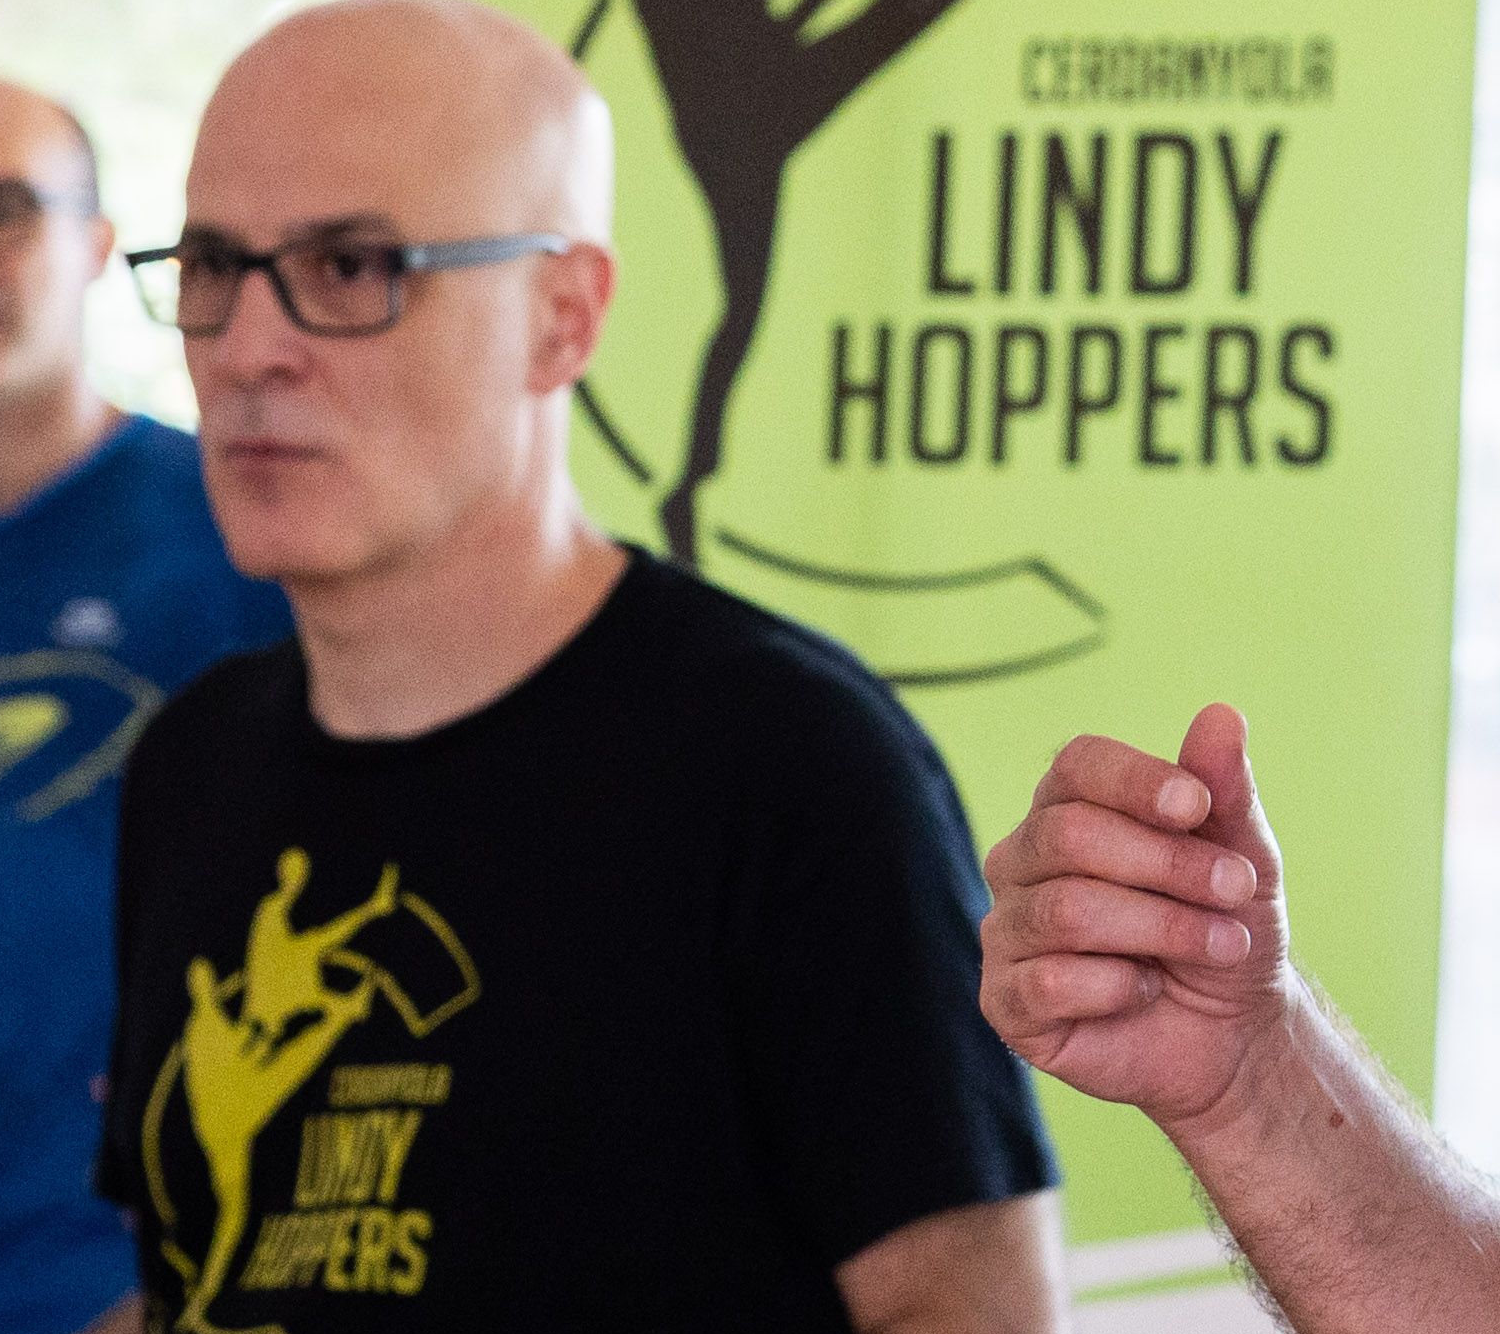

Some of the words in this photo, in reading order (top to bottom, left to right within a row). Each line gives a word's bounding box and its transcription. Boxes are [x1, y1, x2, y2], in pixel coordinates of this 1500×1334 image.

[1021, 35, 1334, 105] CERDANYOLA
[926, 128, 1283, 295] LINDY
[827, 320, 1336, 469] HOPPERS
[294, 1108, 422, 1205] LINDY
[239, 1208, 434, 1295] HOPPERS
